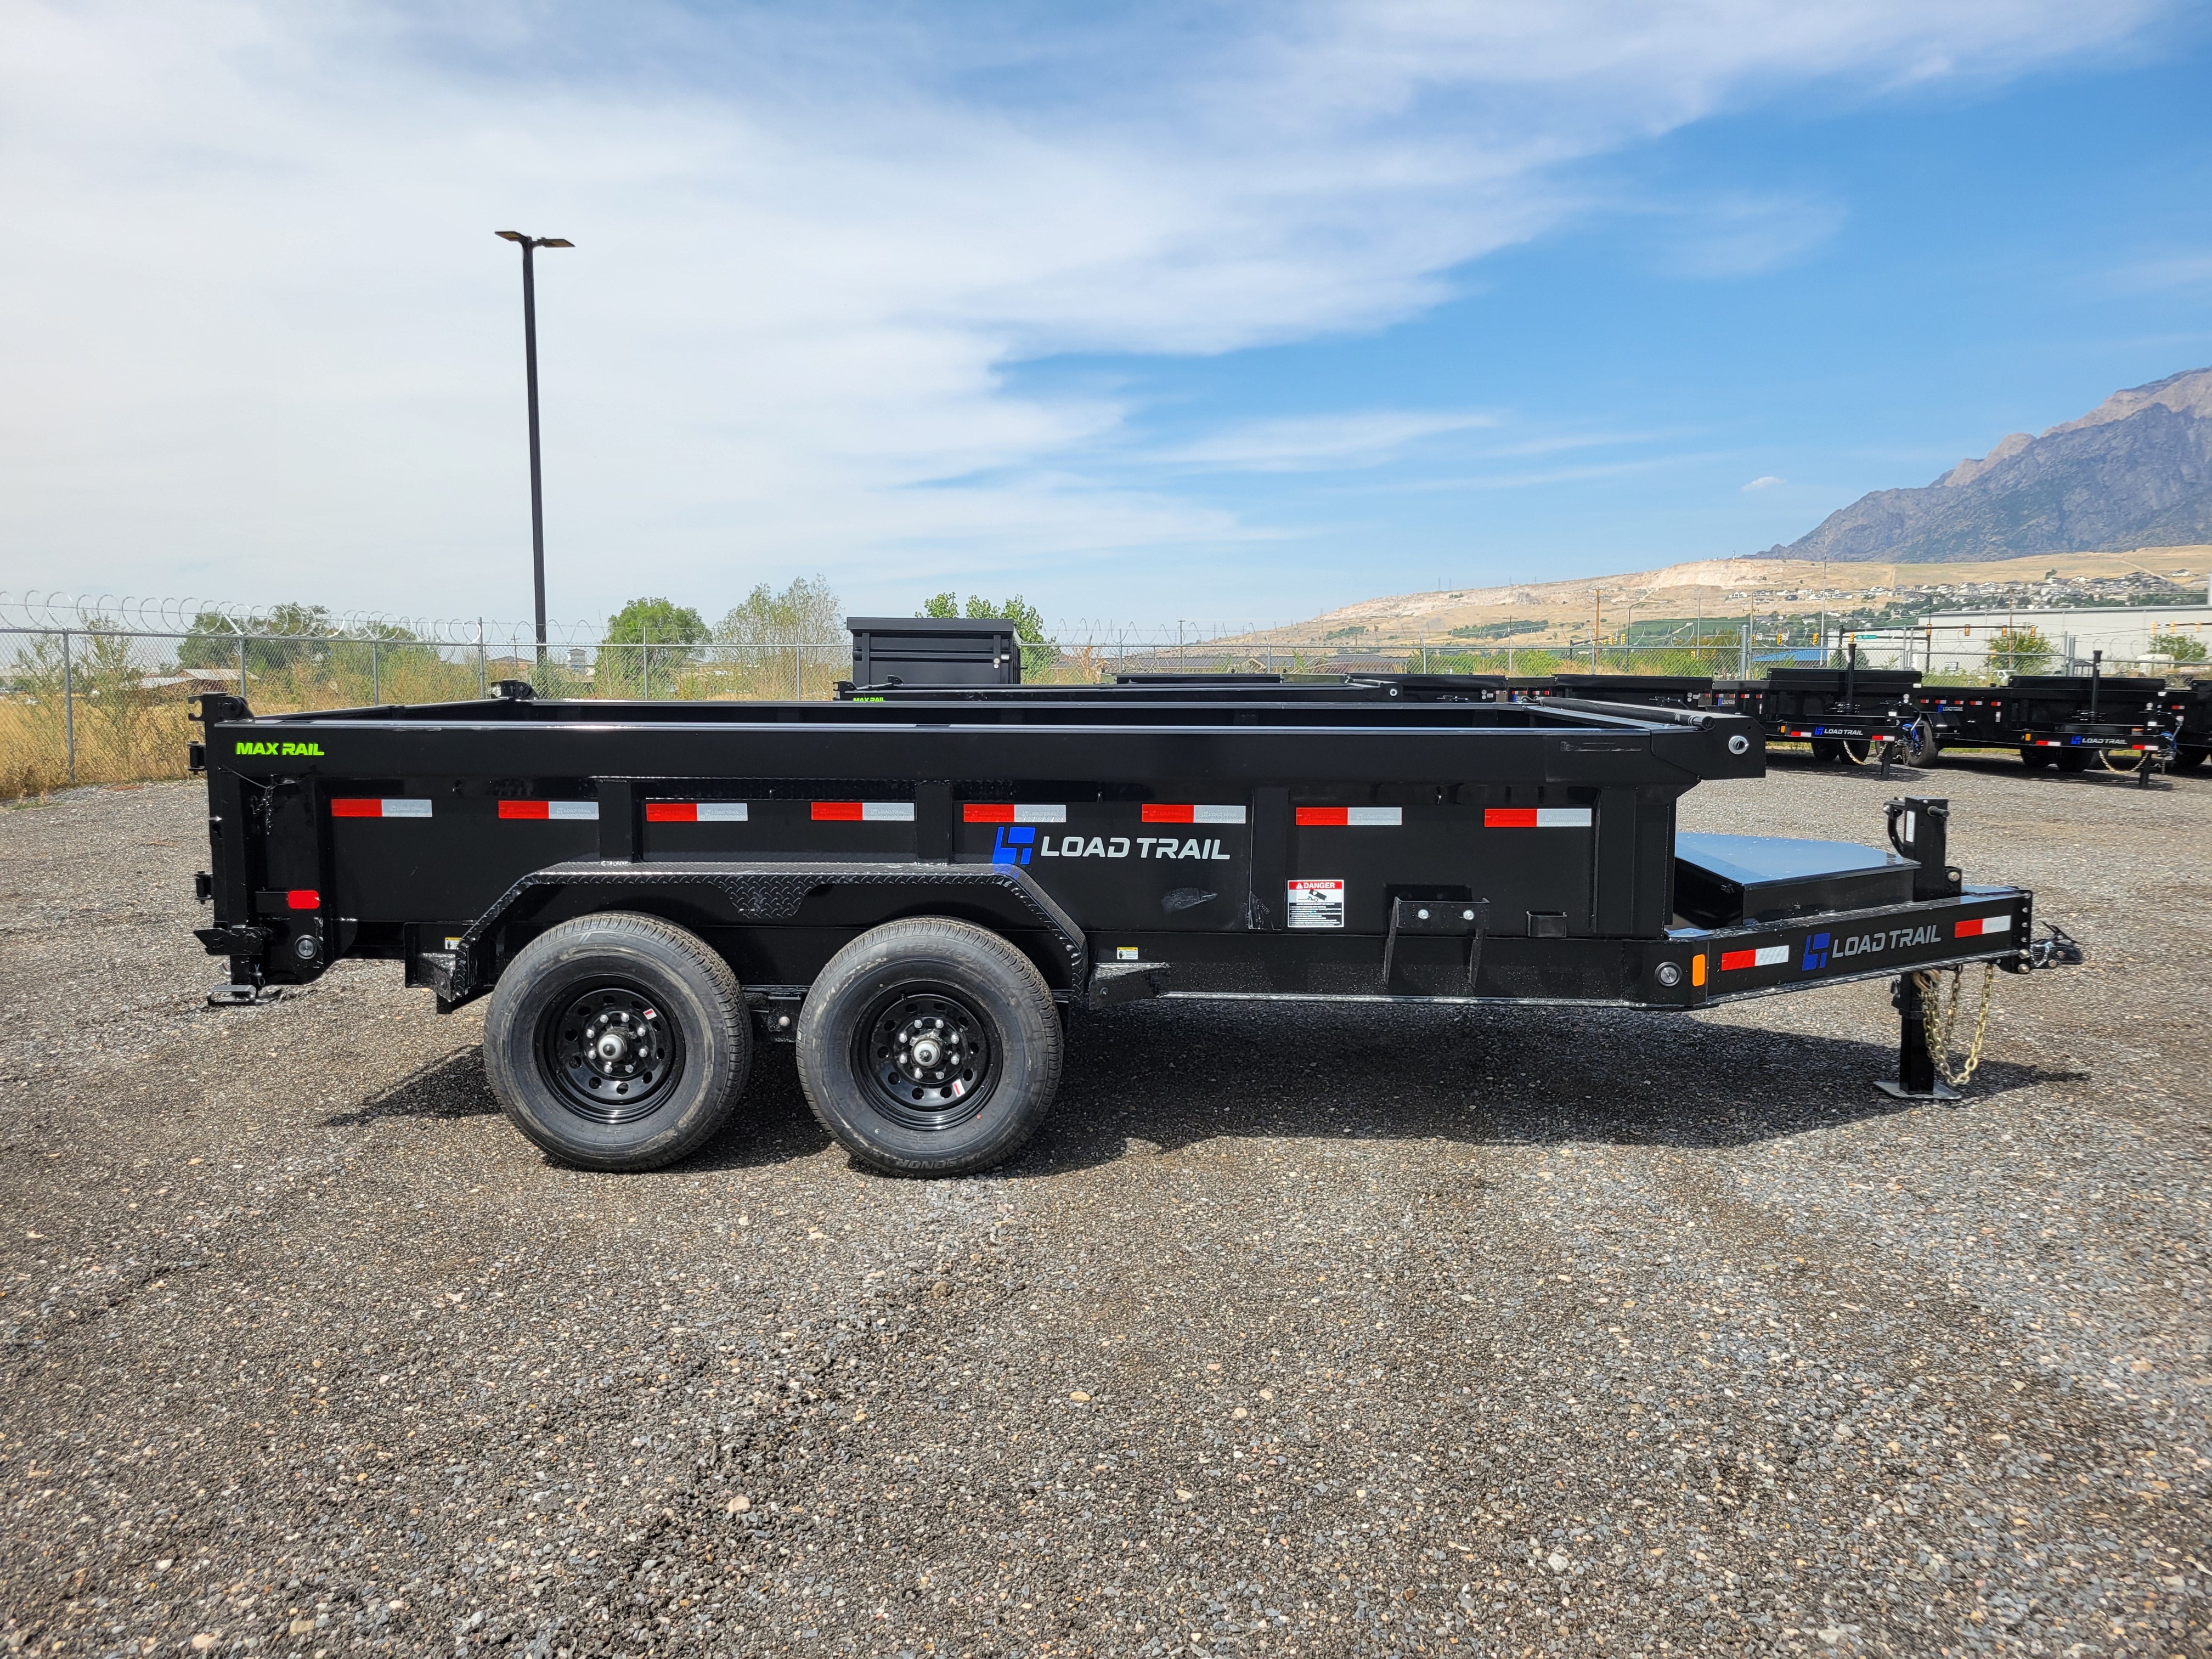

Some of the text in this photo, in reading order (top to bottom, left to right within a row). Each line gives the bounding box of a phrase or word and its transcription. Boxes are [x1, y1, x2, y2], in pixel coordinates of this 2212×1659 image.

[236, 742, 325, 755] MAX RAIL
[1040, 836, 1231, 860] LOAD TRAIL
[1832, 924, 1942, 958] LOAD TRAIL
